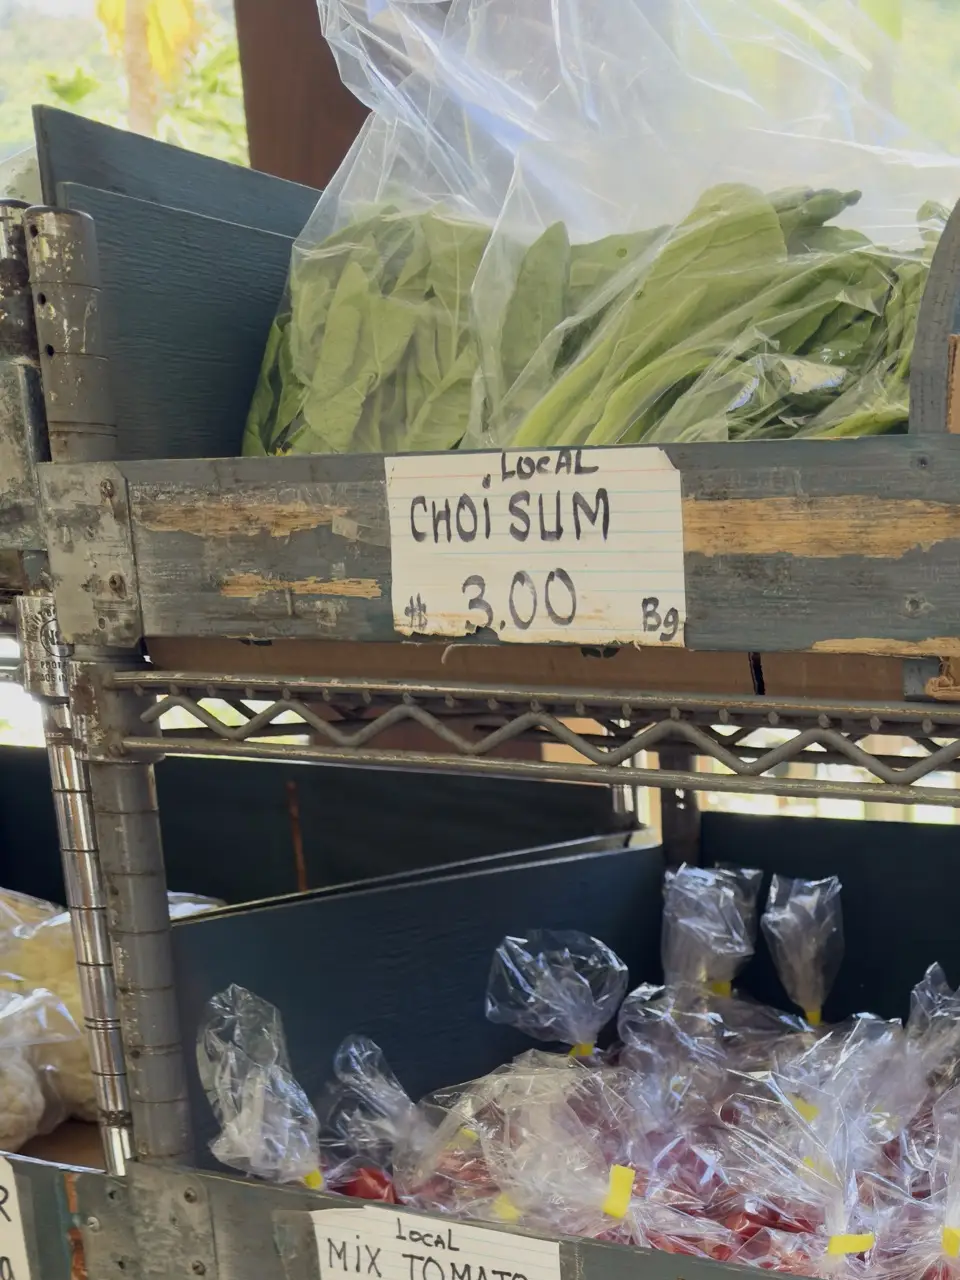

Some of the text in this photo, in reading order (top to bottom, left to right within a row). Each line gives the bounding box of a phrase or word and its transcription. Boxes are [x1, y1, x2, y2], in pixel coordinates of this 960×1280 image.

[508, 486, 611, 543] SUM
[461, 567, 577, 631] 3.00
[641, 596, 680, 641] Bg
